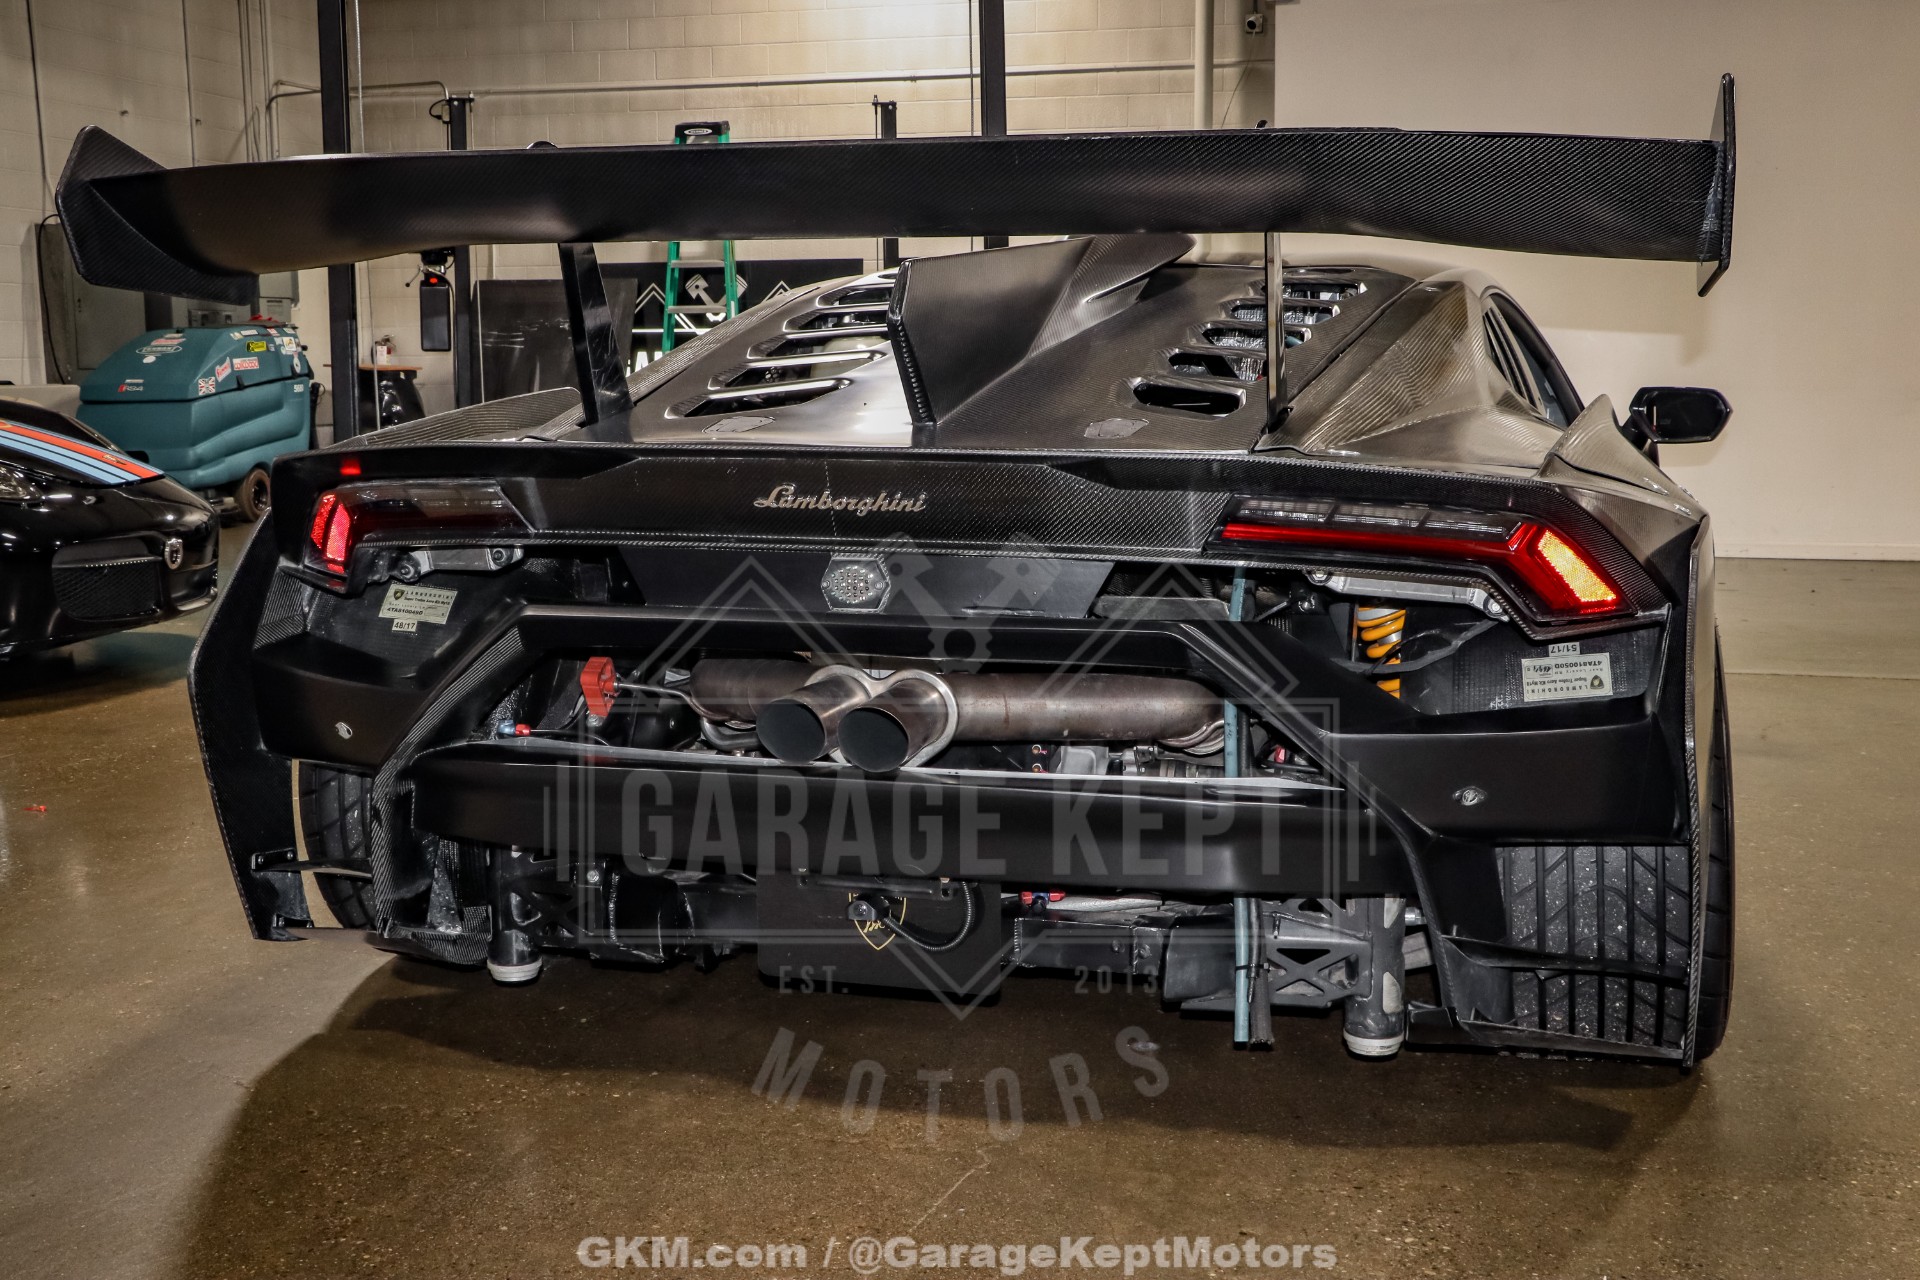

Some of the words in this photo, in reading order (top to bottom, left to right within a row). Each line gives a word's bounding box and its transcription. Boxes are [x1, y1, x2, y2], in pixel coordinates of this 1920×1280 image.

[753, 482, 927, 517] Lamborghini
[394, 621, 416, 629] 48/17
[1550, 644, 1577, 654] 51/17
[1526, 684, 1588, 694] LAMBORGHINI
